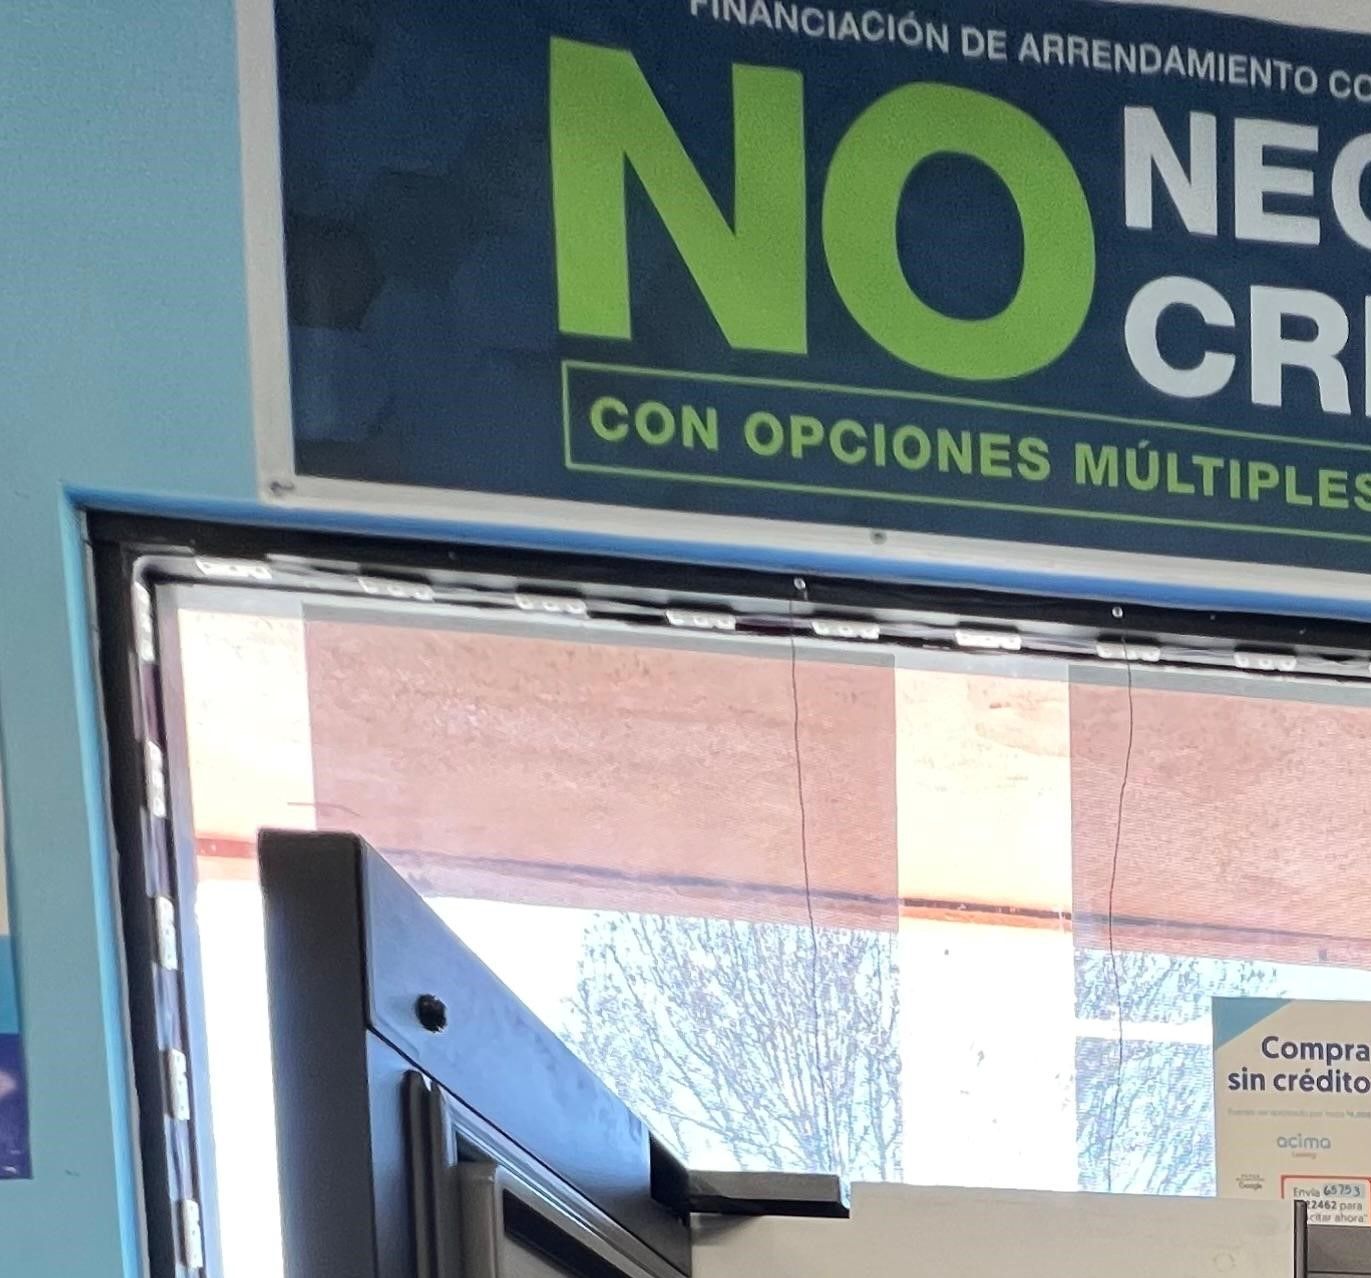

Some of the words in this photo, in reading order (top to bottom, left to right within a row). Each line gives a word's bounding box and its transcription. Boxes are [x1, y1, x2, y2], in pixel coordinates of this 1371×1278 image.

[962, 26, 1007, 61] DE
[1019, 34, 1318, 94] ARRENDAMIENTO
[550, 36, 1095, 381] NO
[589, 397, 719, 450] CON
[744, 410, 1051, 481] OPCIONES
[1261, 1036, 1371, 1065] Compra
[1228, 1067, 1265, 1091] sin
[1273, 1068, 1371, 1093] crédito
[1277, 1133, 1331, 1149] acima
[1340, 1202, 1363, 1213] para
